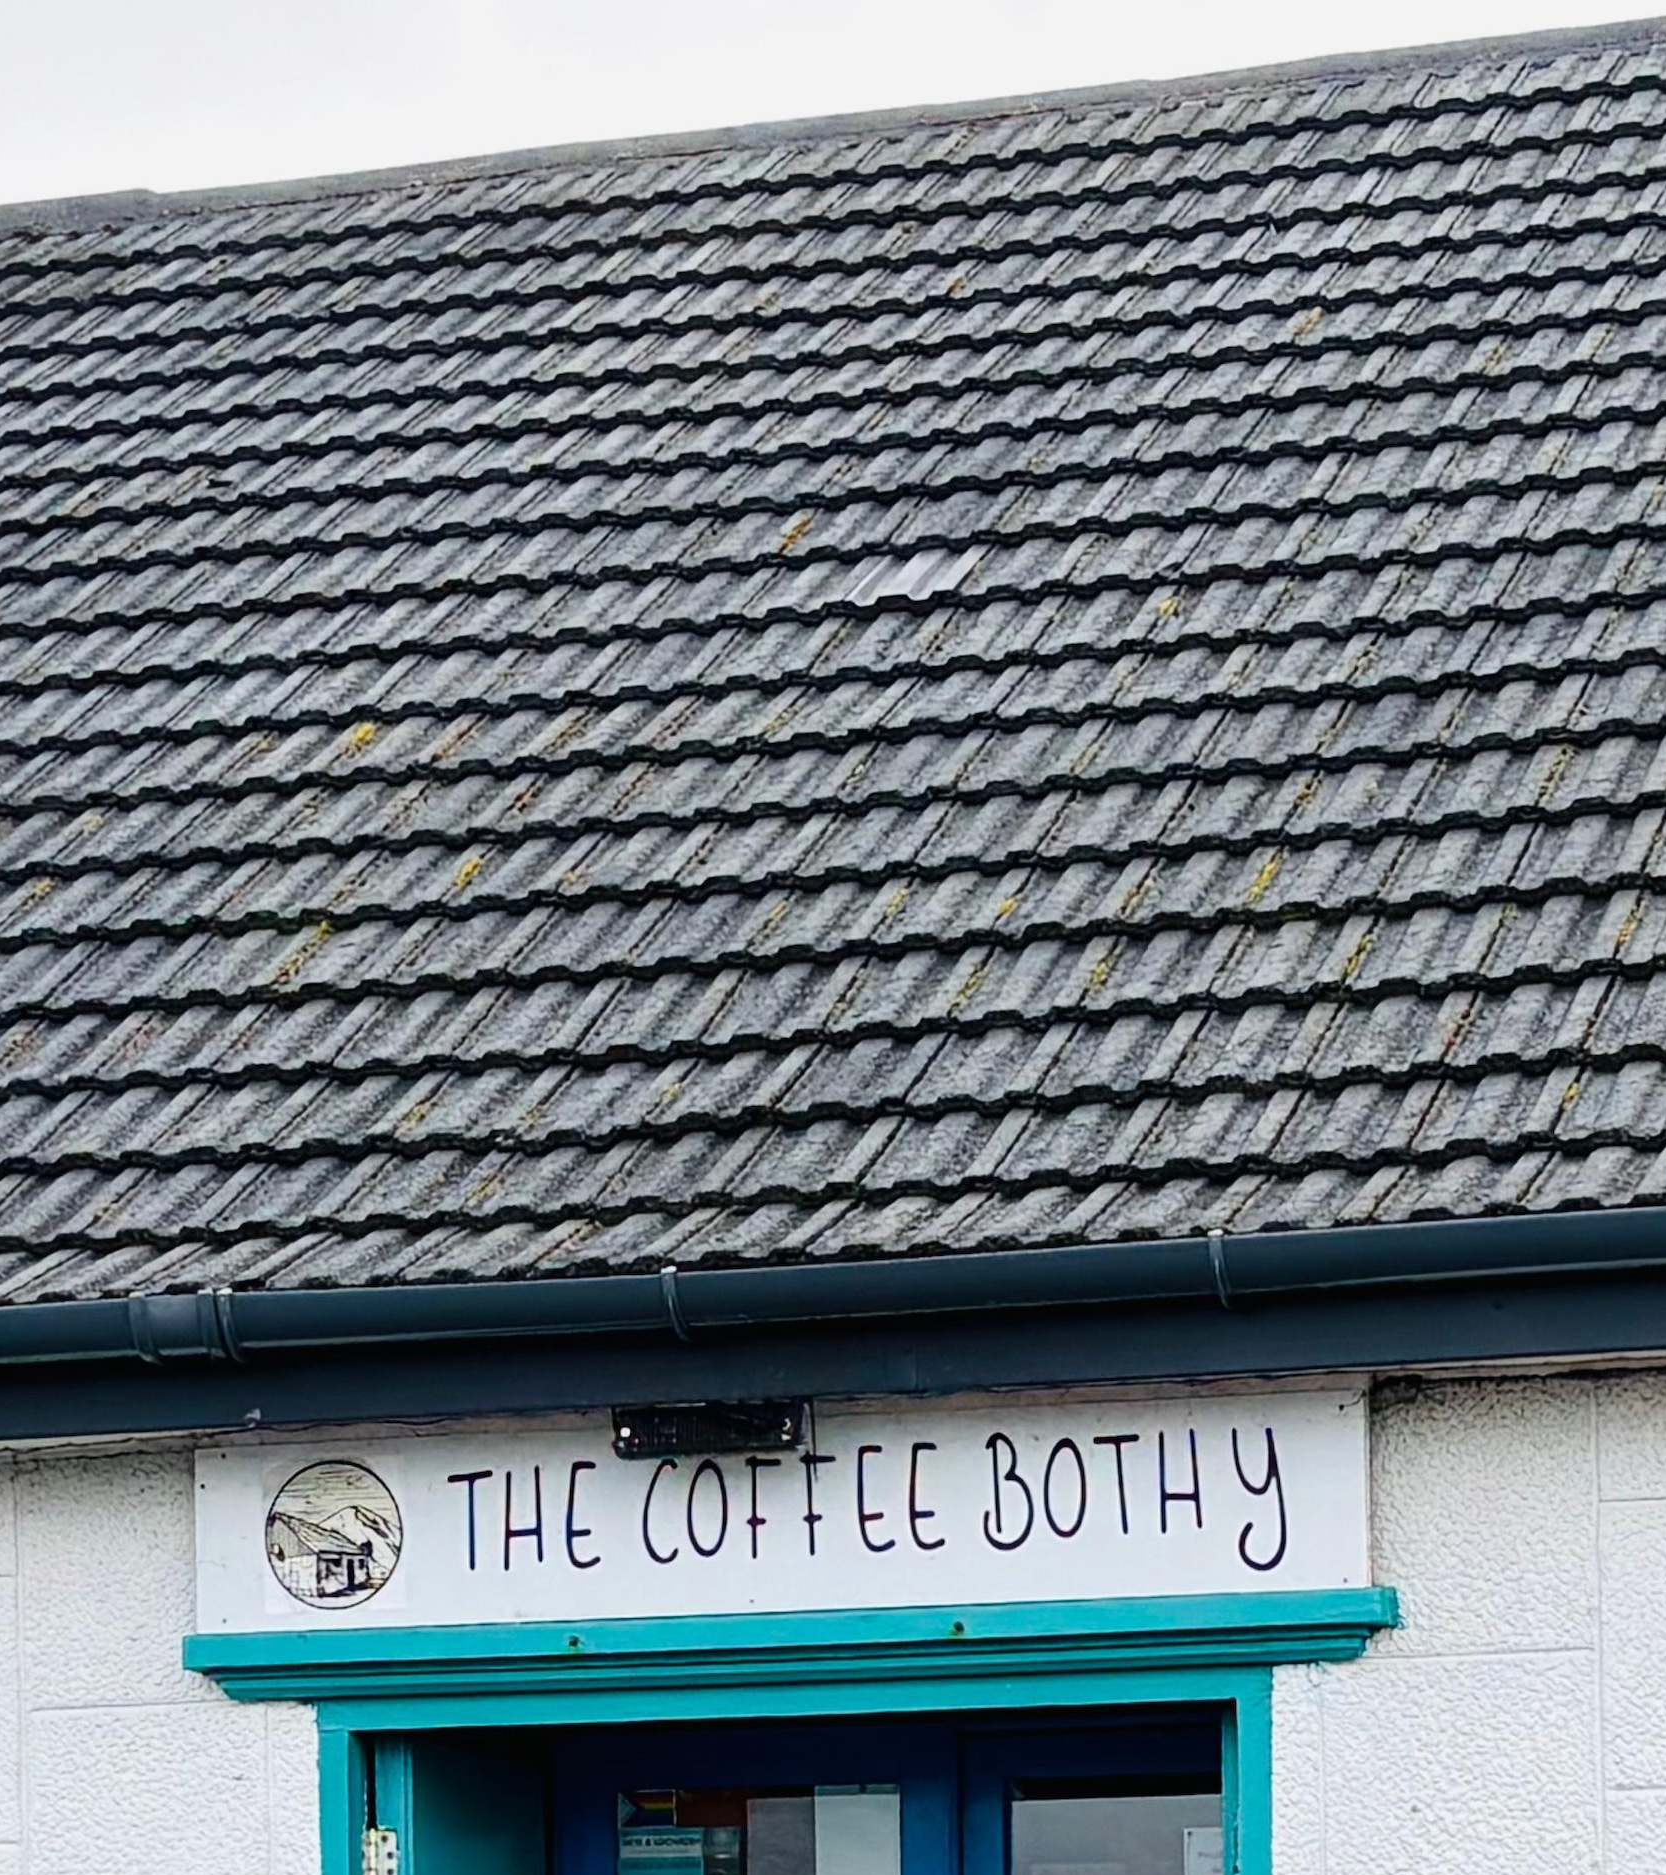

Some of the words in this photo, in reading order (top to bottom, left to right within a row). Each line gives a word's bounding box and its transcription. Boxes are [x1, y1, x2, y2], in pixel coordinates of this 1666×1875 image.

[447, 1460, 602, 1572] THE
[641, 1440, 948, 1565] COFFEE
[983, 1427, 1289, 1572] BOTHY
